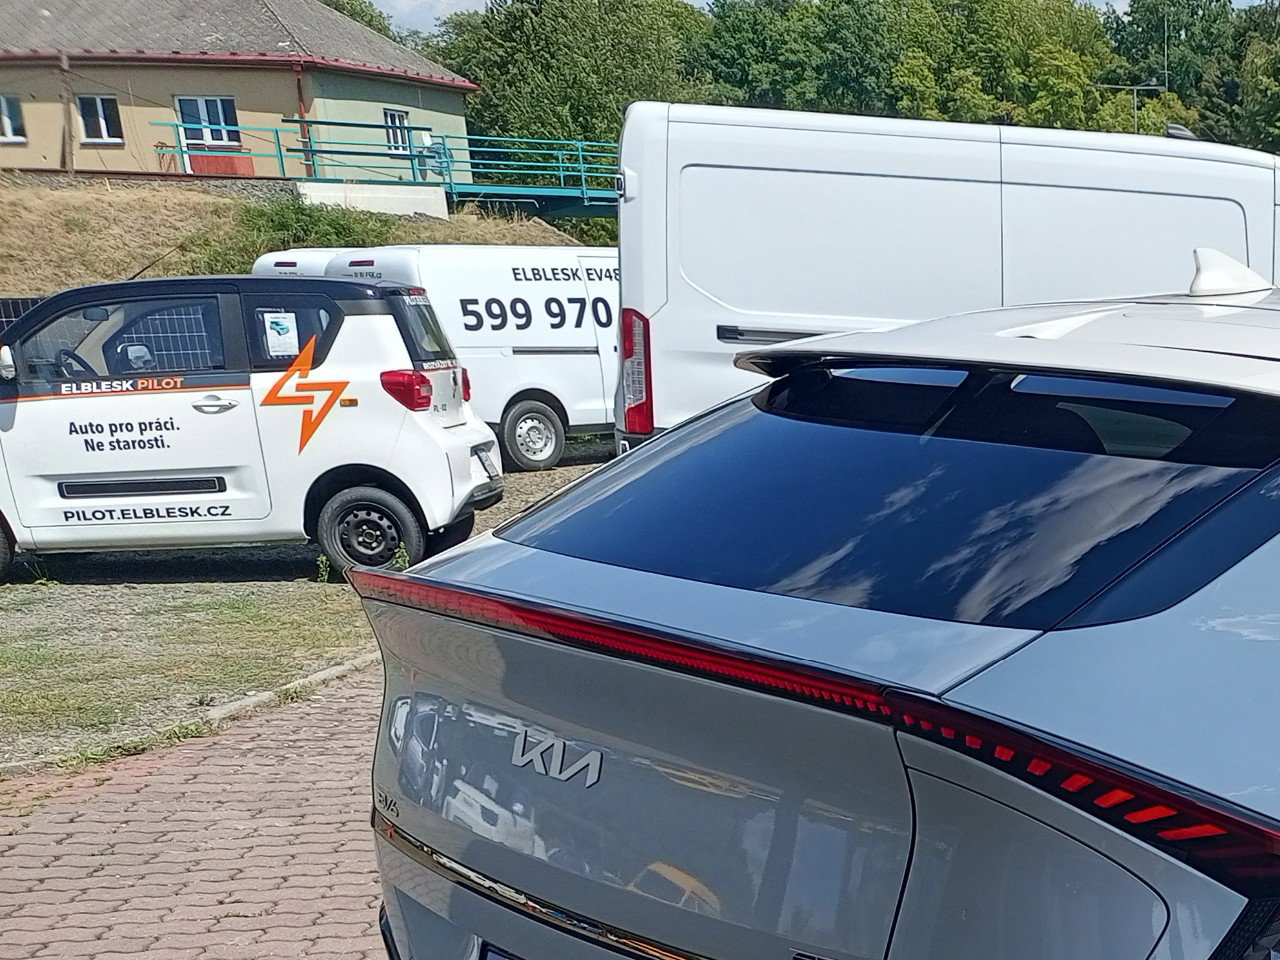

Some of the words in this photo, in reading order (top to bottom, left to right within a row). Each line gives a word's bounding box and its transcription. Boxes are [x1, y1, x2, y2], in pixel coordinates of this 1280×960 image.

[511, 267, 582, 282] ELBLESK
[459, 297, 532, 332] 599
[544, 297, 613, 329] 970
[61, 380, 134, 394] ELBLESK
[137, 378, 185, 390] PILOT
[69, 421, 104, 435] Auto
[108, 421, 134, 437] pro
[138, 417, 181, 436] práci.
[84, 438, 105, 452] Ne
[108, 435, 171, 450] starosti.
[63, 505, 232, 522] PILOT.ELBLESK.CZ
[511, 729, 604, 789] KIA
